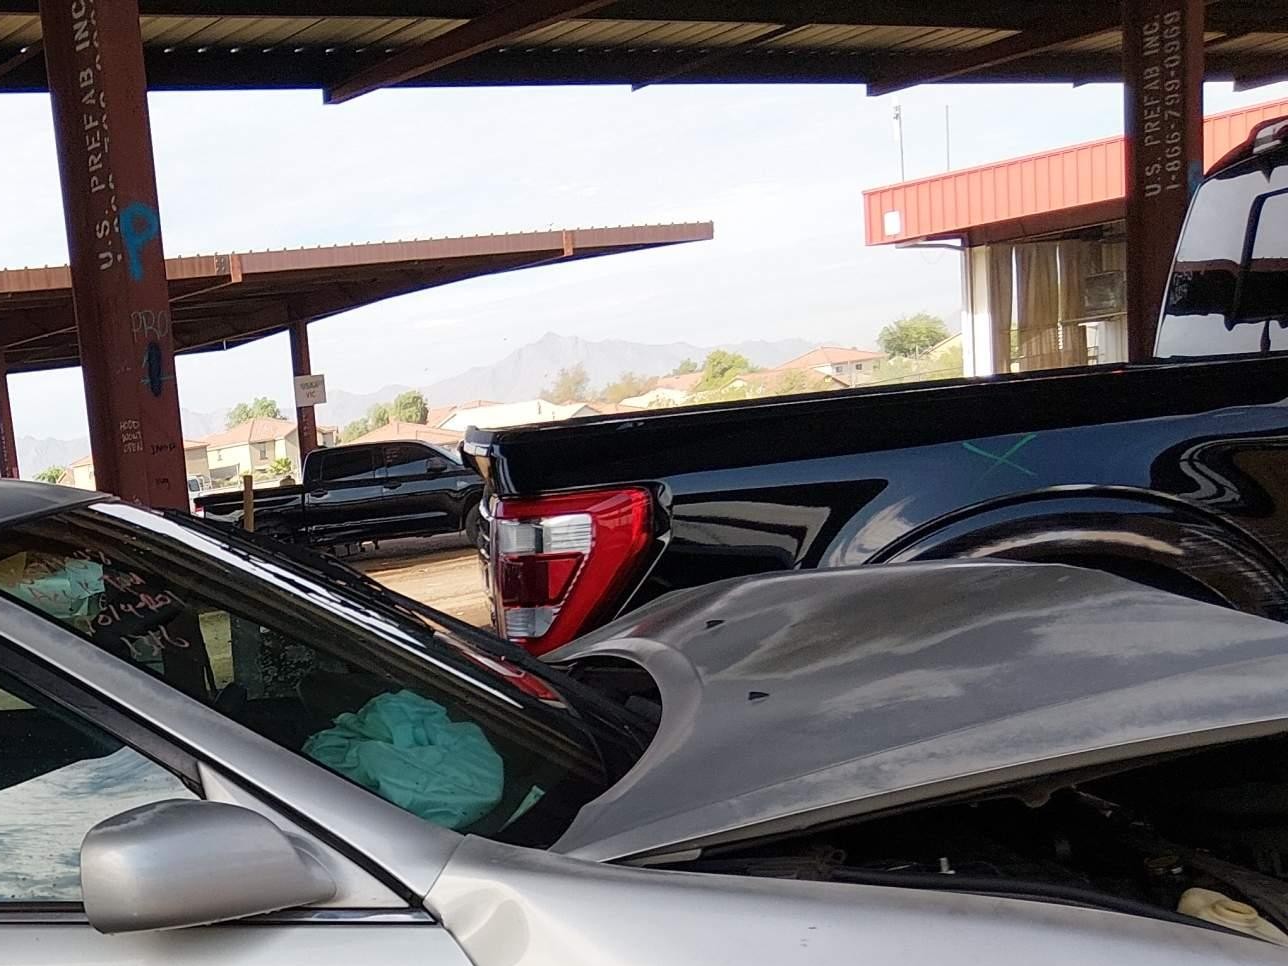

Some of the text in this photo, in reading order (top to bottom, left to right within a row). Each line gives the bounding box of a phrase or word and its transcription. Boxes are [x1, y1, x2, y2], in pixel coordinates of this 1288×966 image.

[80, 67, 106, 193] PREFAB
[1143, 14, 1162, 198] U.S. PREFAB INC.
[1164, 10, 1181, 191] 1-866-799-0969
[96, 209, 114, 271] U.S.
